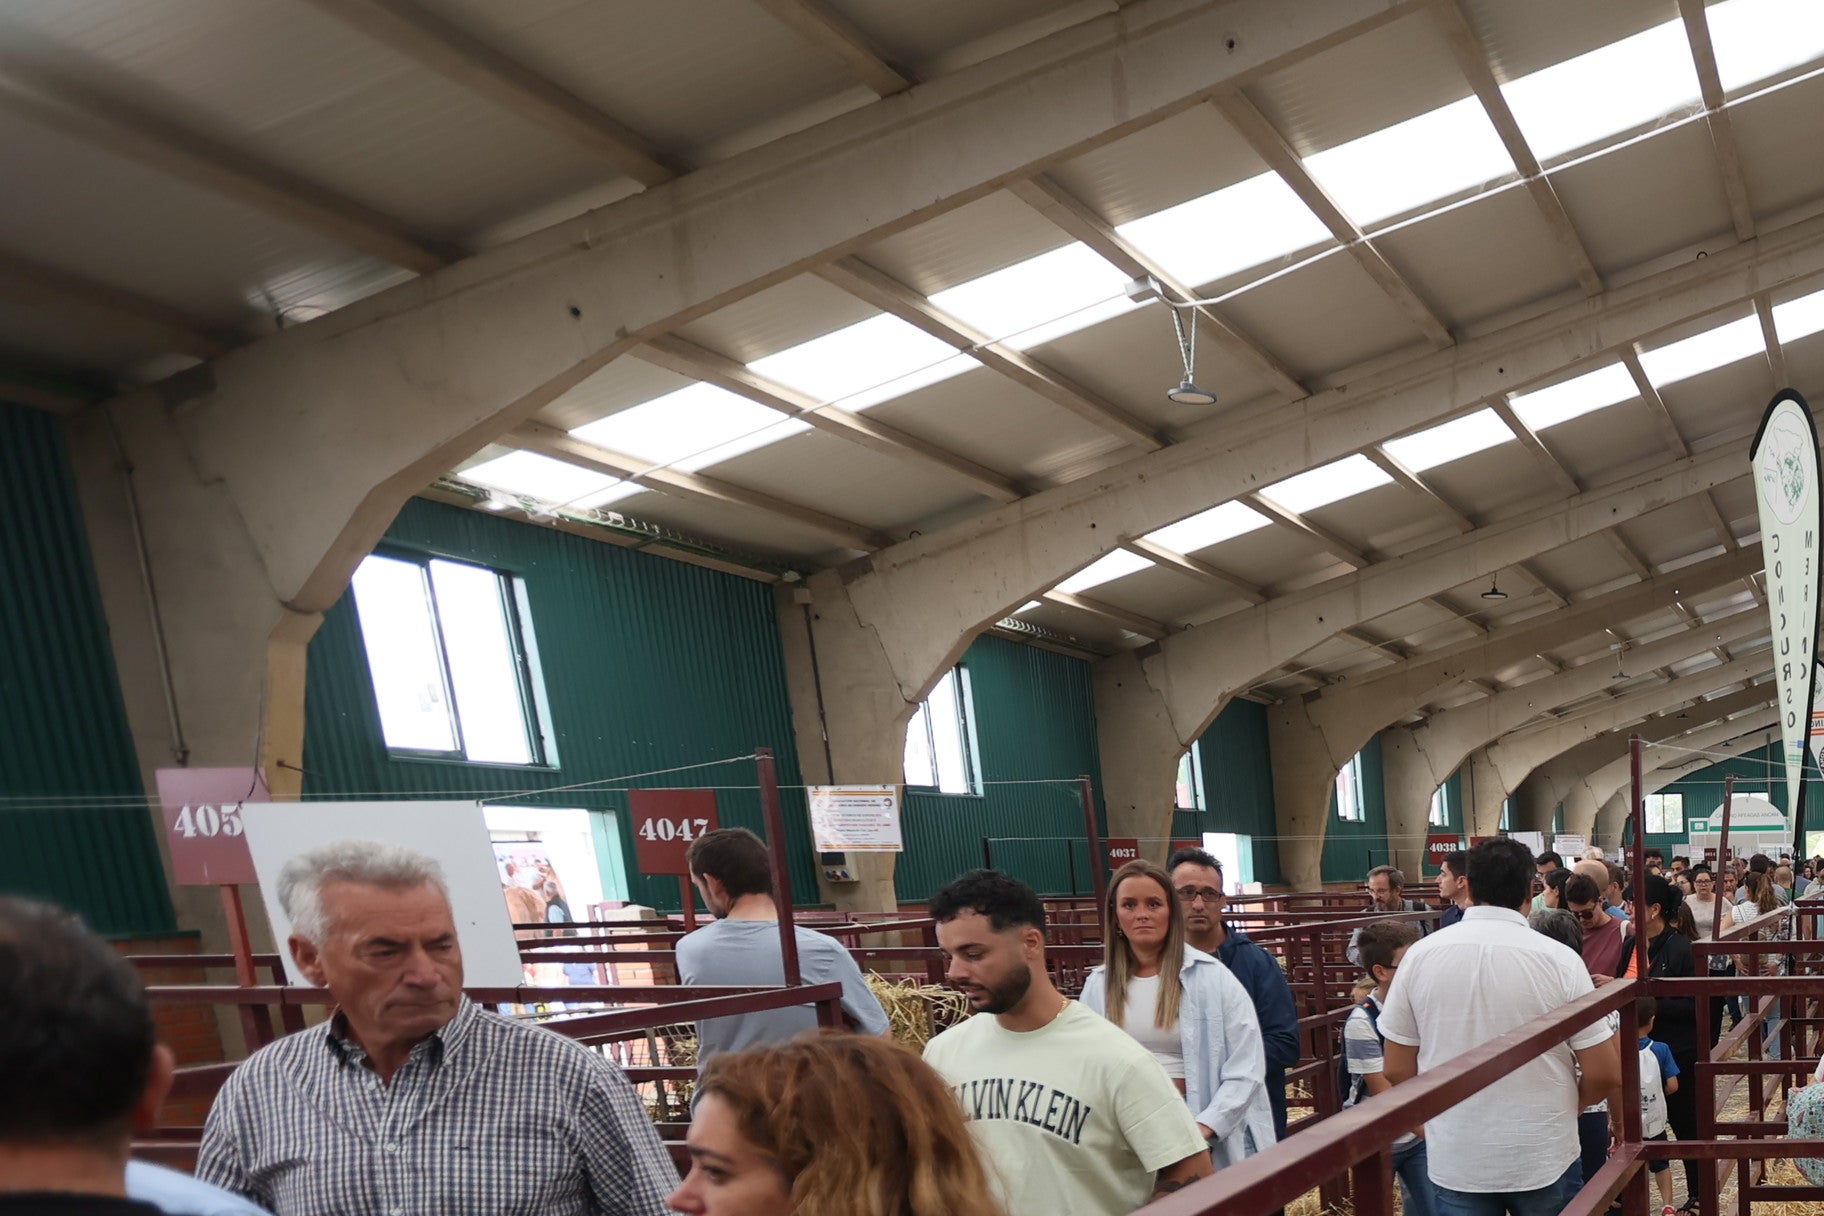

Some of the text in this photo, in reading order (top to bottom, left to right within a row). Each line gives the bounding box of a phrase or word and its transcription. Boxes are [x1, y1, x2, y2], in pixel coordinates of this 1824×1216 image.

[173, 803, 244, 838] 405
[639, 817, 709, 841] 4047
[1109, 848, 1136, 858] 4037
[1429, 842, 1457, 852] 4038
[953, 1078, 1092, 1146] LVIN KLEIN
